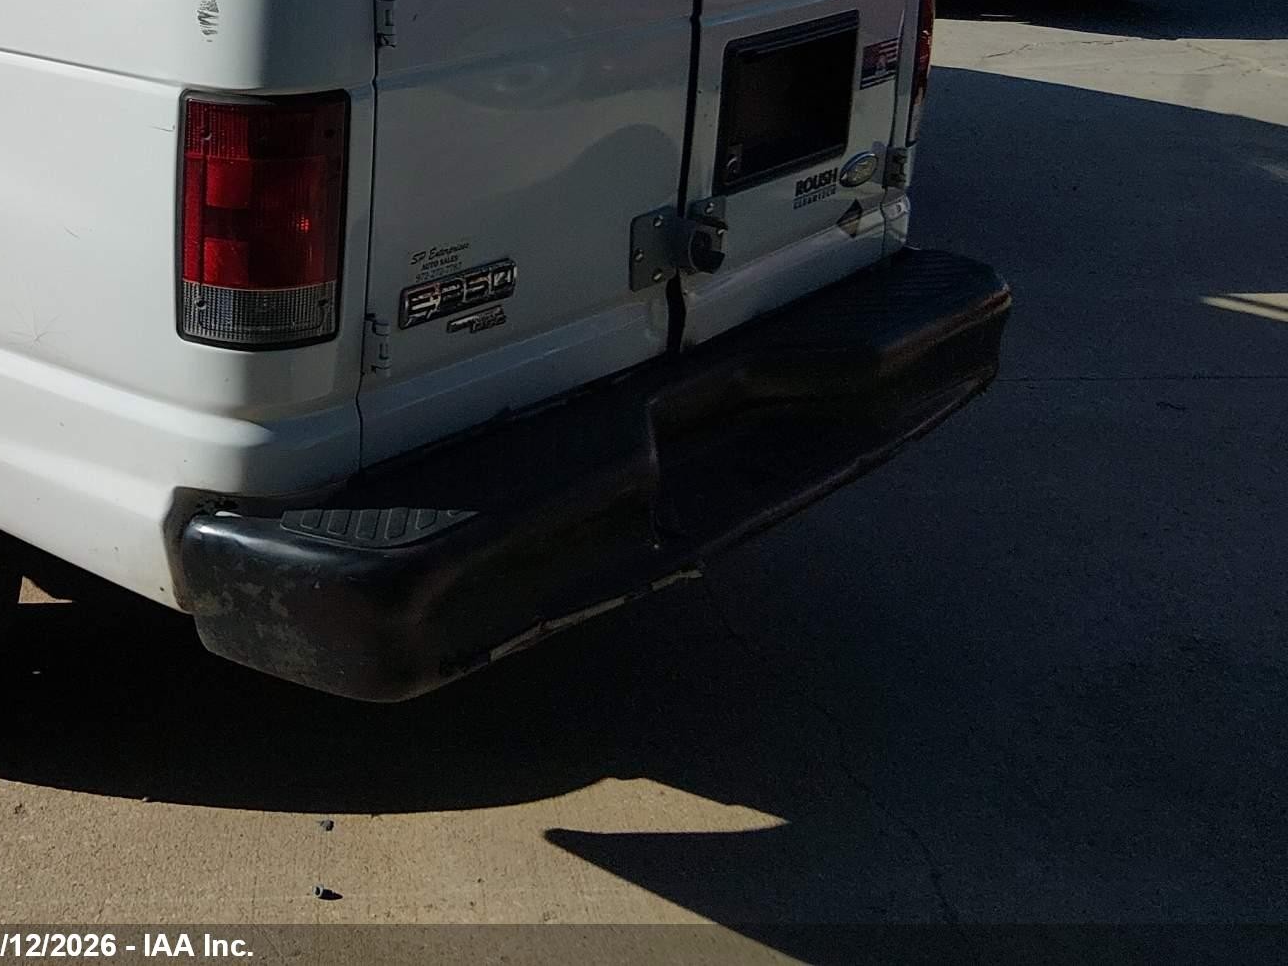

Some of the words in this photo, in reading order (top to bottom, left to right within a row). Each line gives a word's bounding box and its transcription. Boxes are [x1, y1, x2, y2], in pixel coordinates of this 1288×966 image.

[796, 167, 838, 196] ROUSH
[422, 261, 439, 271] AUTO
[440, 255, 459, 265] SALES
